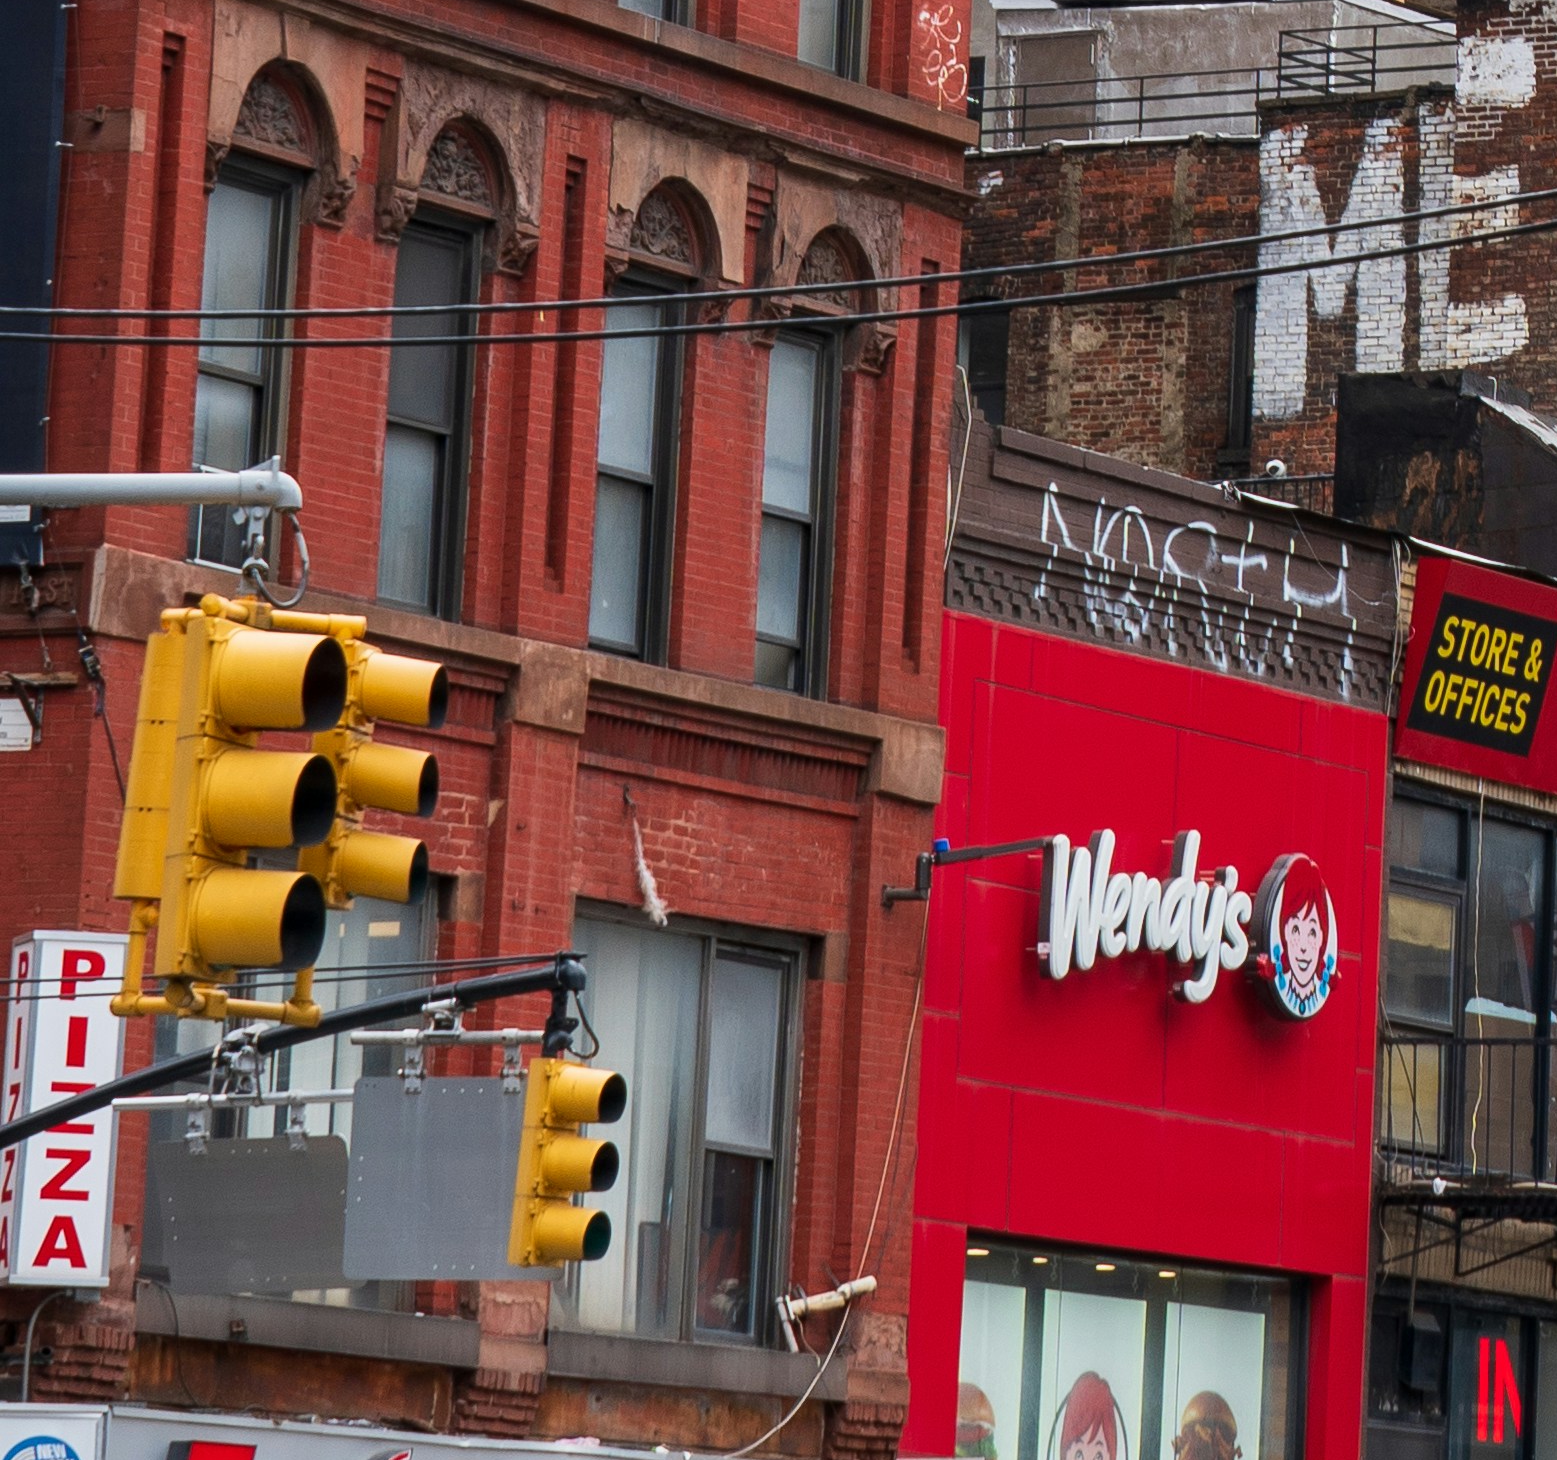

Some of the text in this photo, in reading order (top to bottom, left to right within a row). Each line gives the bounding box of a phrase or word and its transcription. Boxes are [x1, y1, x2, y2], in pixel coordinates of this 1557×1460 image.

[1437, 615, 1544, 683] STORE &
[1424, 670, 1531, 736] OFFICES
[1050, 828, 1253, 1004] Wendy's
[37, 1444, 67, 1460] NEW
